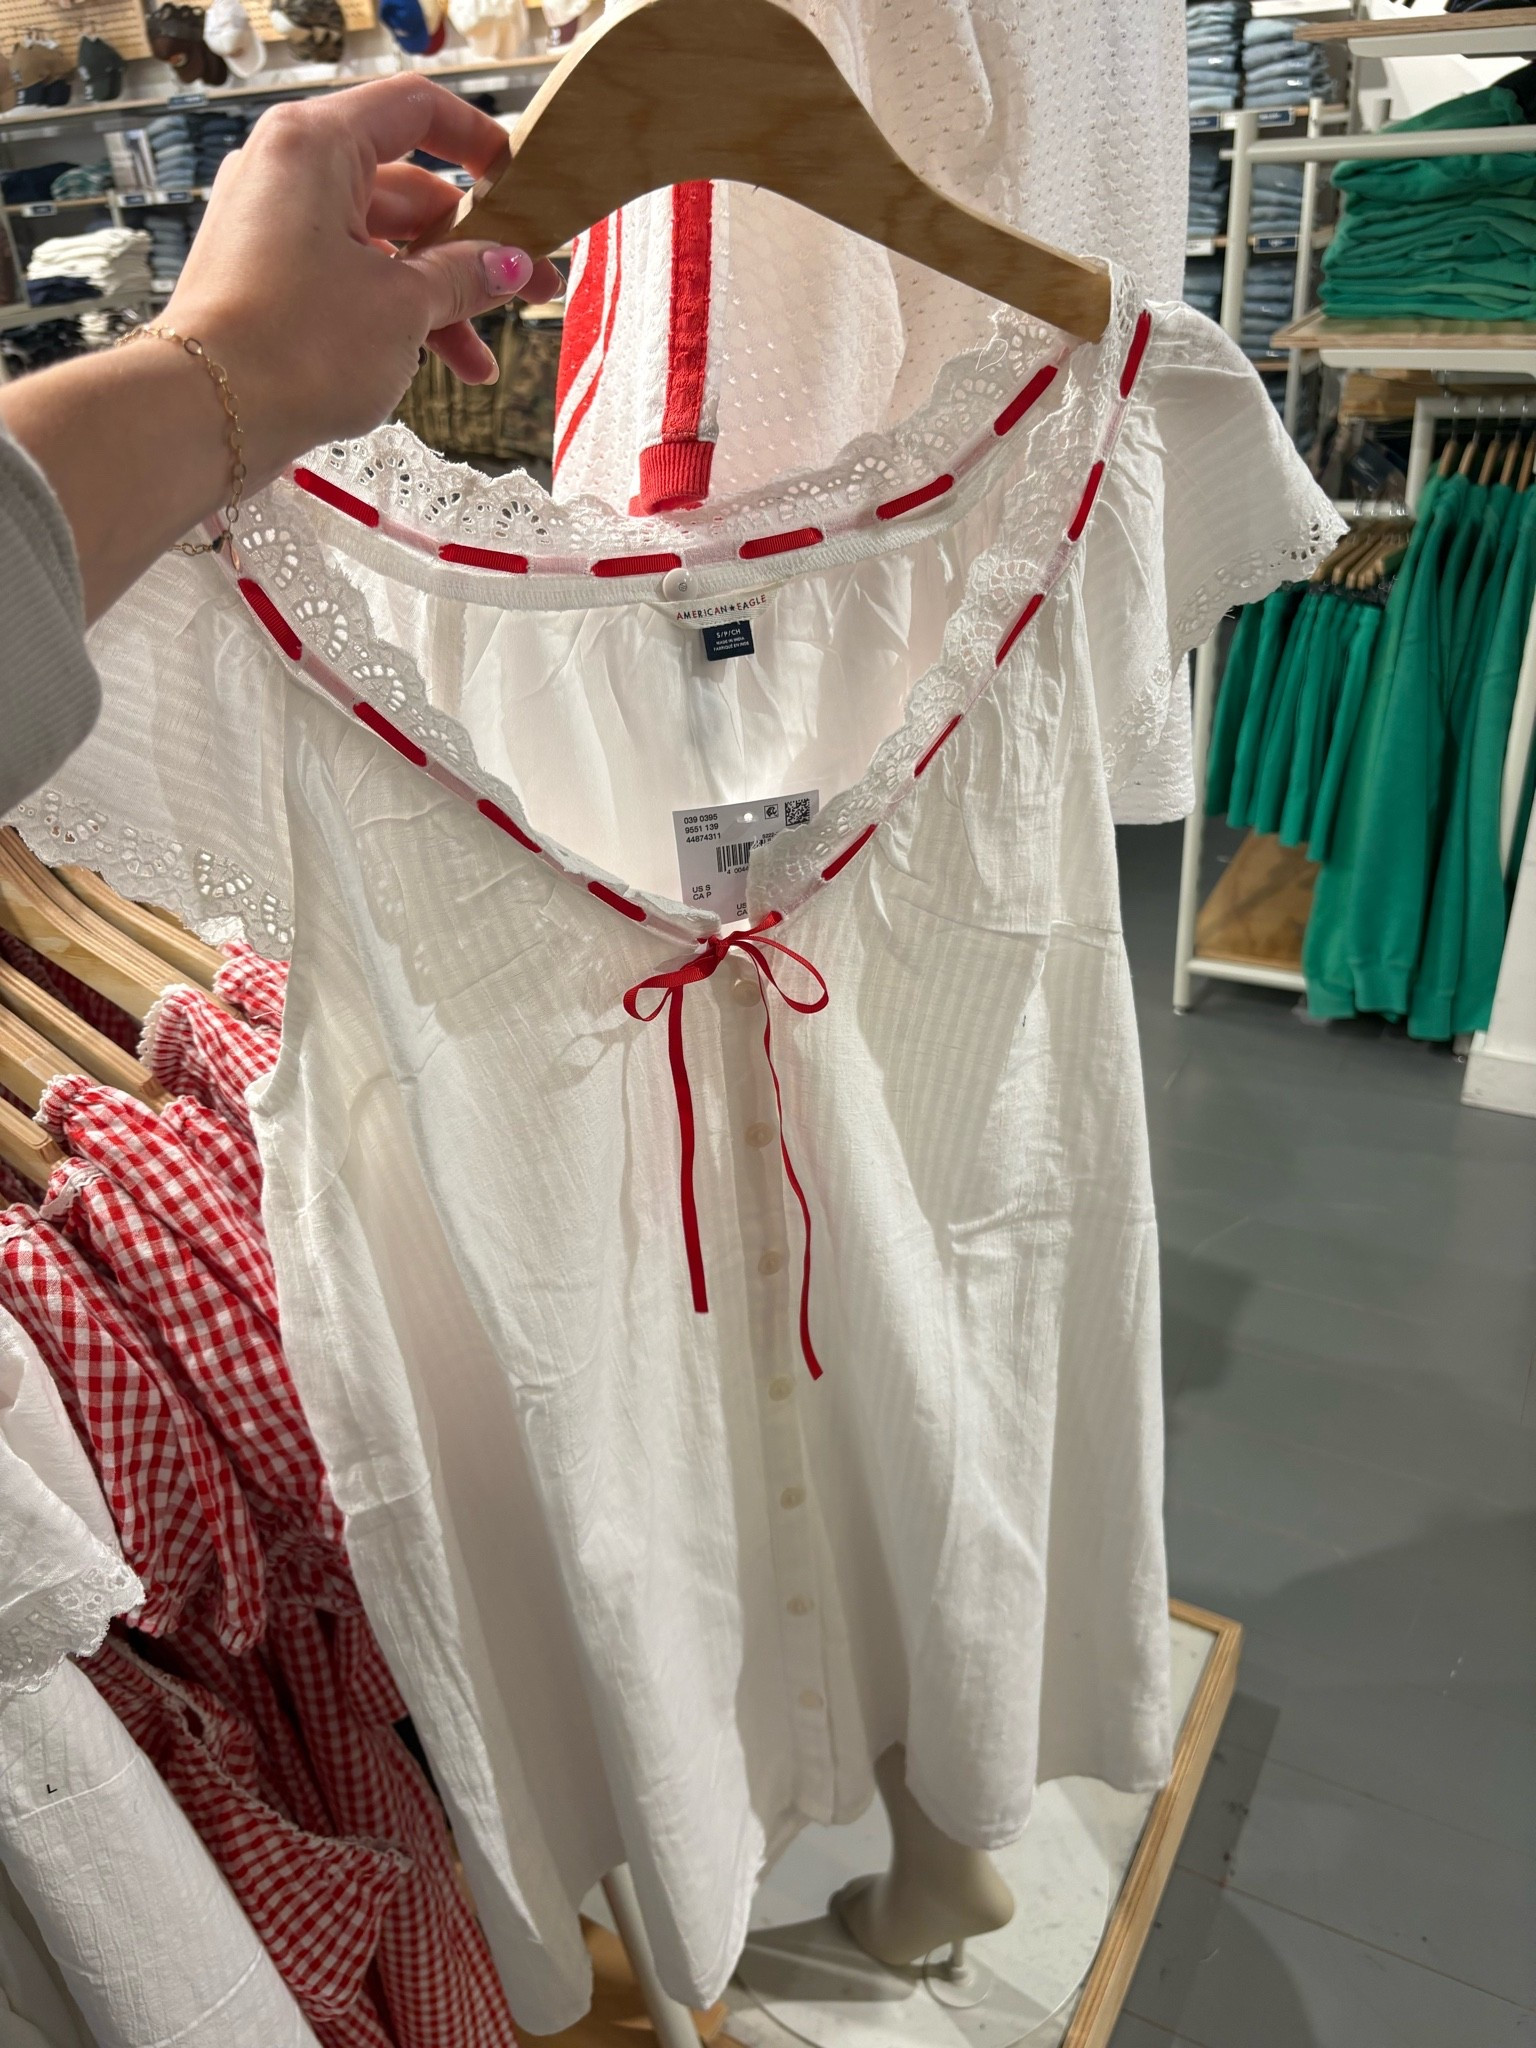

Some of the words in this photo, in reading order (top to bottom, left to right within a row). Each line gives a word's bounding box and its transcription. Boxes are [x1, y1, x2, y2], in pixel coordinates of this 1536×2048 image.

[676, 605, 727, 620] AMERICAN
[736, 594, 767, 611] EAGLE
[716, 628, 741, 638] S/P/CH
[684, 816, 698, 824] 039
[699, 813, 718, 822] 0395
[685, 825, 703, 834] 9551
[705, 823, 719, 831] 139
[686, 832, 721, 843] 44874311
[692, 885, 704, 893] US
[736, 902, 747, 910] US
[736, 909, 748, 917] CA
[47, 1784, 58, 1794] L
